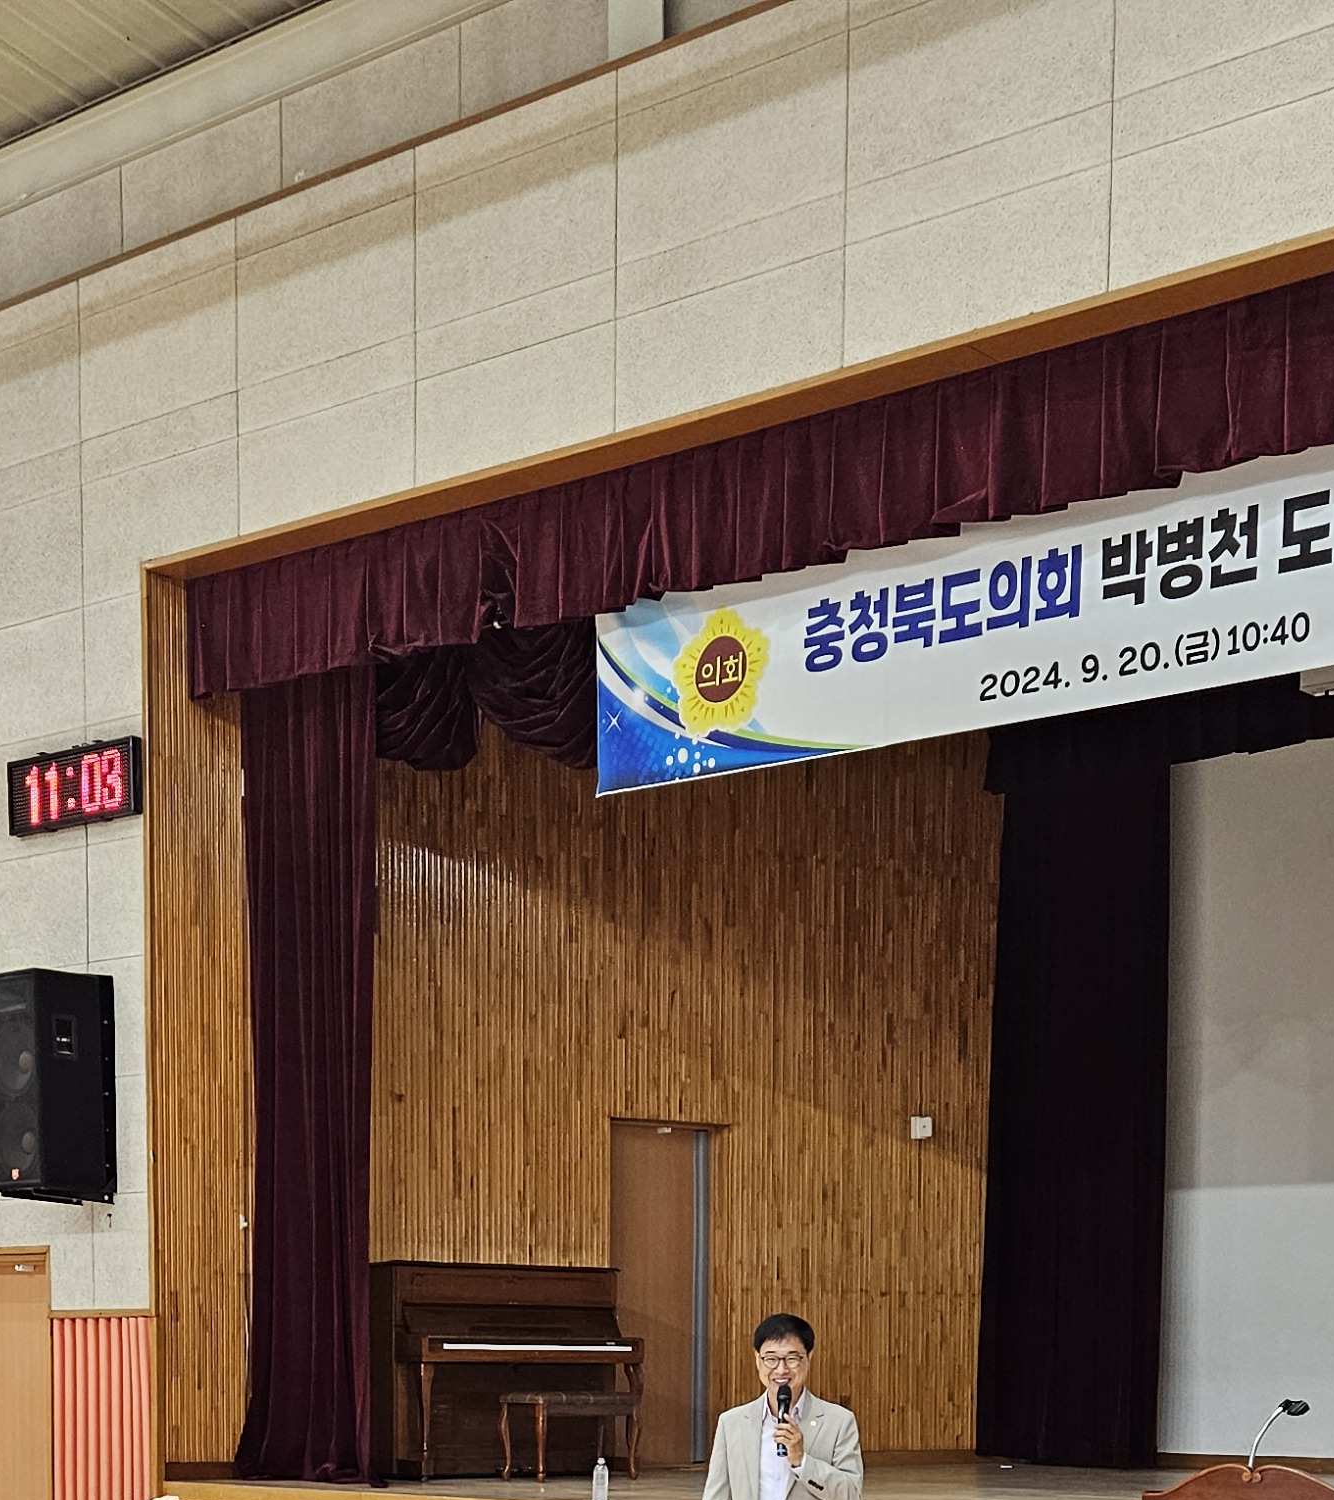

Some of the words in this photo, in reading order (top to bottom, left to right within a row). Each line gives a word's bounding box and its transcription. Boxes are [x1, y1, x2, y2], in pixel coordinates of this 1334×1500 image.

[803, 544, 1083, 674] 충청북도의회
[1101, 503, 1260, 607] 박병천
[698, 651, 743, 688] 의회
[979, 660, 1071, 701] 2024.
[1081, 653, 1109, 683] 9.
[25, 749, 123, 826] 11:03
